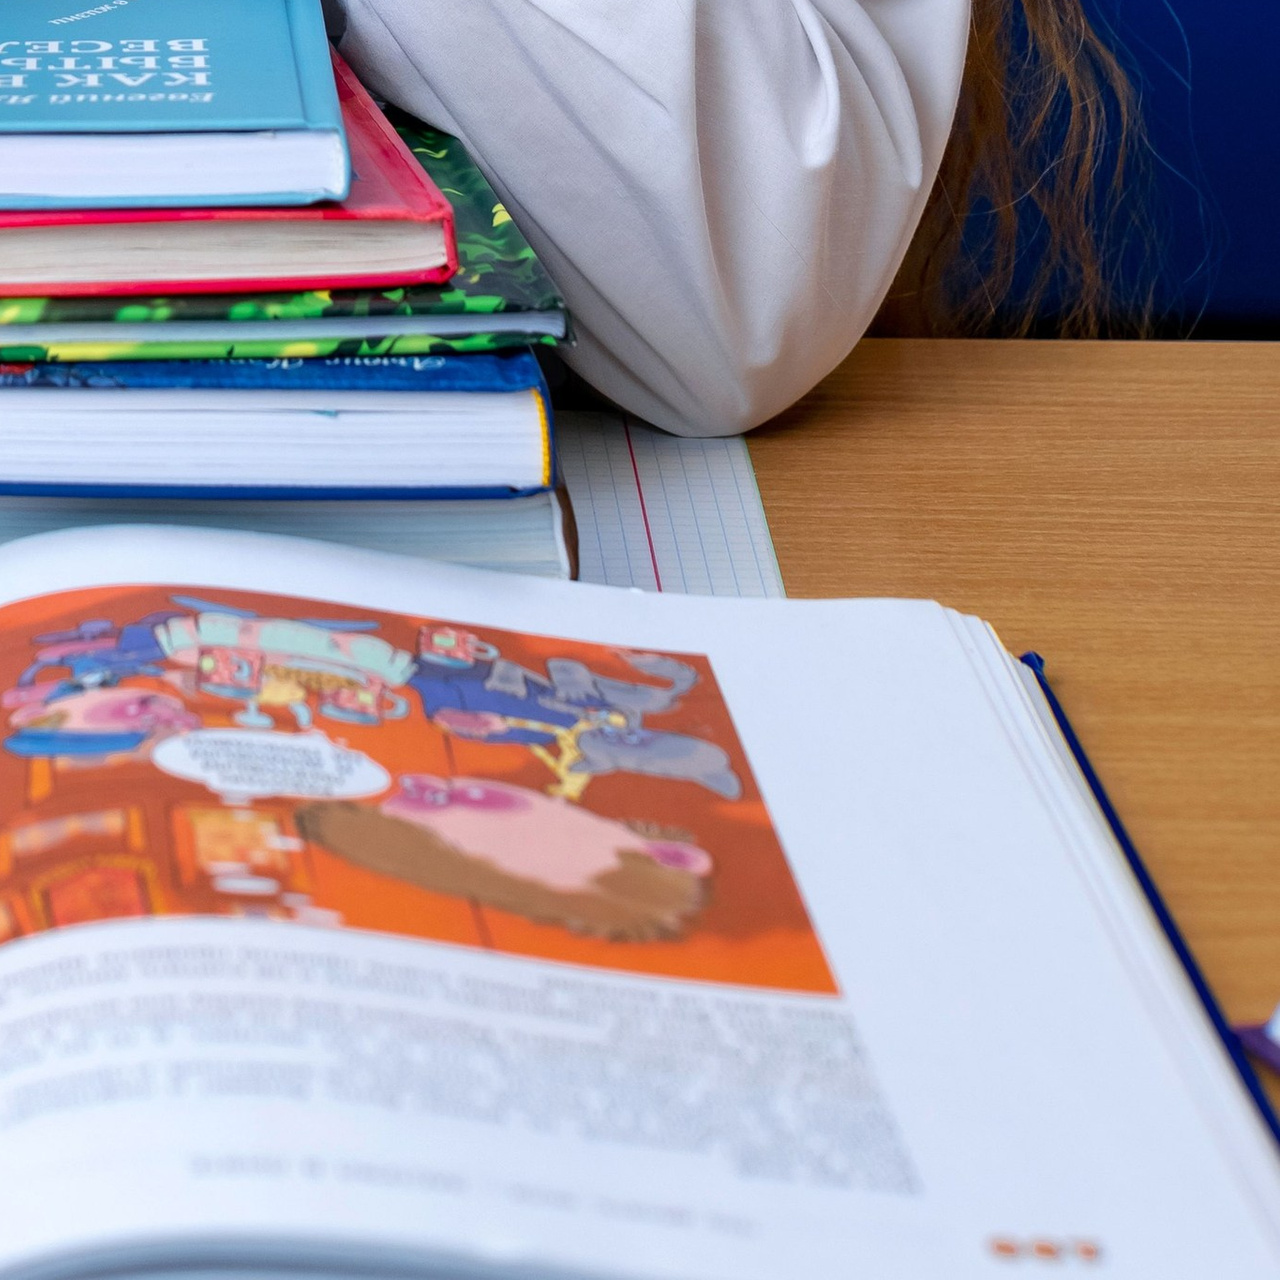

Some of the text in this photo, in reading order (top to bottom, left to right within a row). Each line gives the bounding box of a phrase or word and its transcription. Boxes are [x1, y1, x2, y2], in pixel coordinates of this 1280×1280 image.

[48, 3, 118, 25] жизни
[0, 54, 211, 72] БЫТЬ
[55, 71, 213, 88] КАК
[48, 92, 215, 104] Евгений
